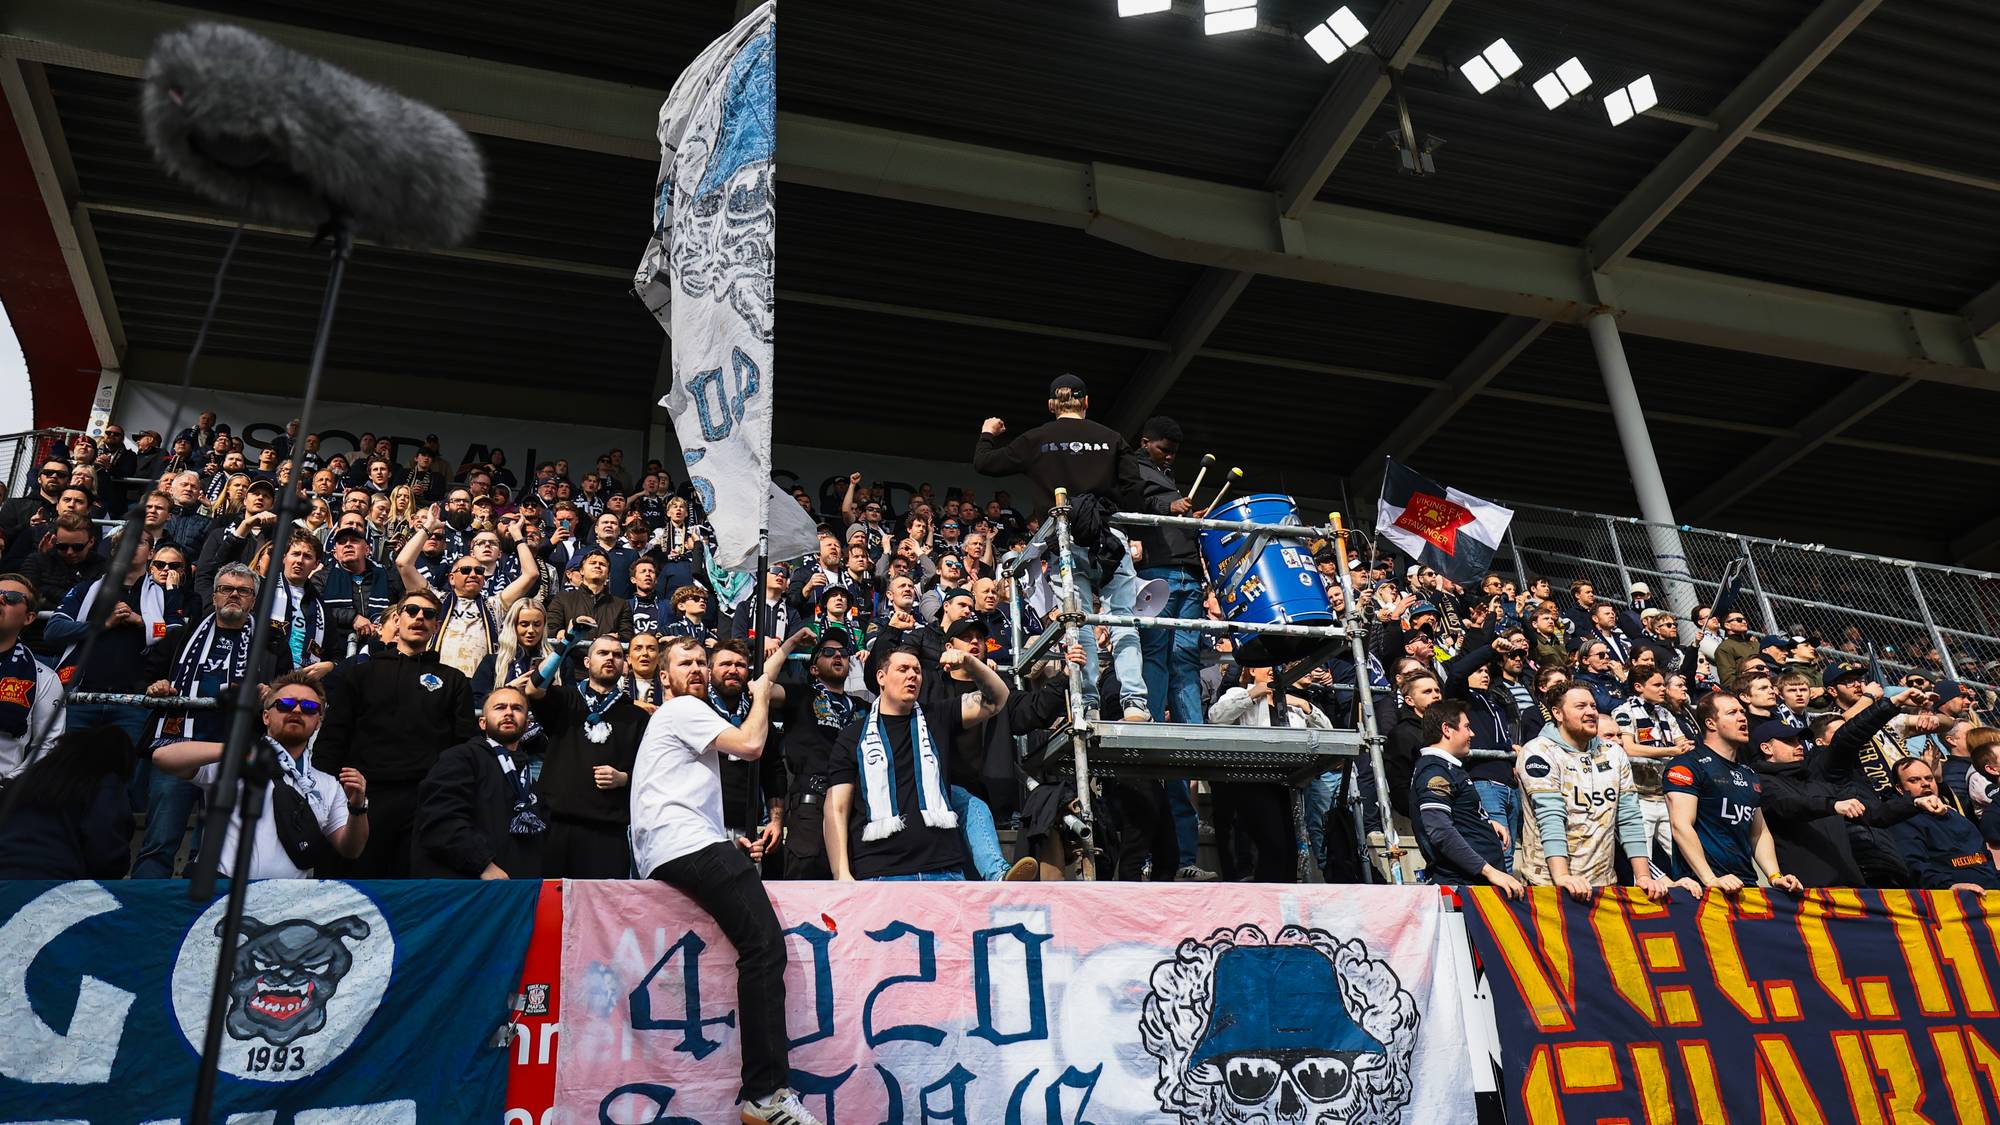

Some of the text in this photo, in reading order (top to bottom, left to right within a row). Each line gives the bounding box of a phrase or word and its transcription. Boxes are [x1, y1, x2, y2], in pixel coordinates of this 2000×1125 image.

[1416, 496, 1447, 512] VIKING
[1400, 517, 1449, 545] STAVANGER
[1574, 786, 1617, 811] Lyse
[246, 1045, 306, 1072] 1993
